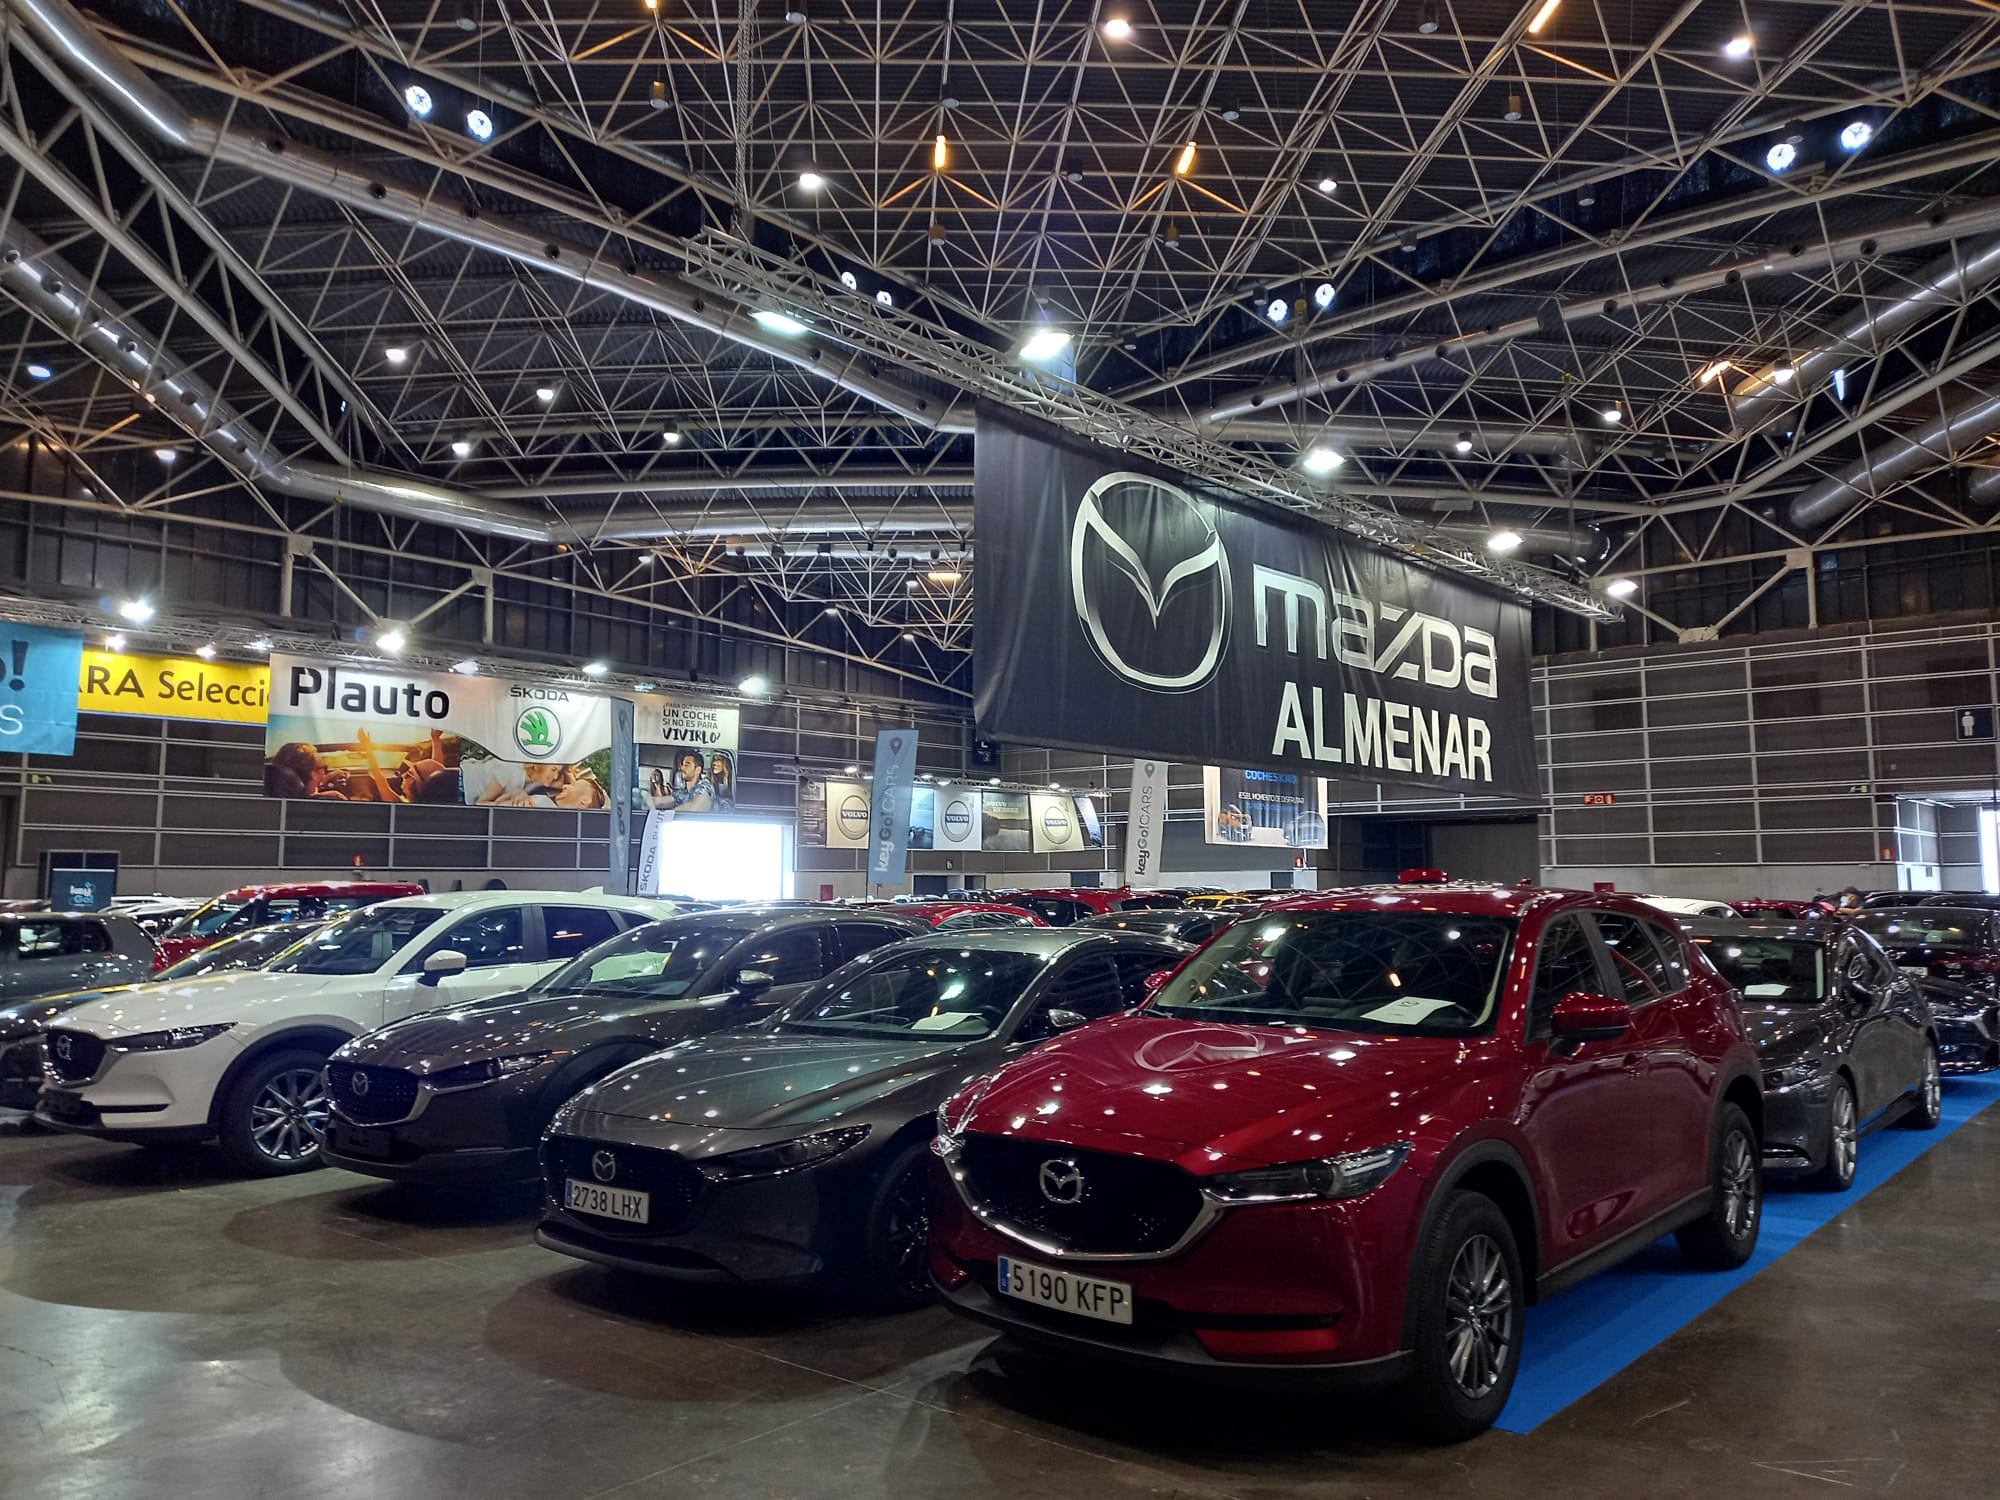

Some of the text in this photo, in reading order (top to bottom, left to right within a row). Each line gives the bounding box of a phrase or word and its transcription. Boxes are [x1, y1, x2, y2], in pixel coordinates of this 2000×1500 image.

[158, 670, 270, 708] Selecci
[290, 666, 450, 720] Plauto
[662, 717, 718, 730] SI NO ES PARA
[663, 709, 717, 721] UN COCHE
[1272, 681, 1493, 782] ALMENAR
[842, 810, 868, 818] VOLVO
[946, 814, 969, 822] VOLVO
[1045, 818, 1067, 827] VOLVO
[573, 1185, 642, 1219] 2738 LHX
[1013, 1264, 1124, 1316] 5190 KFP
